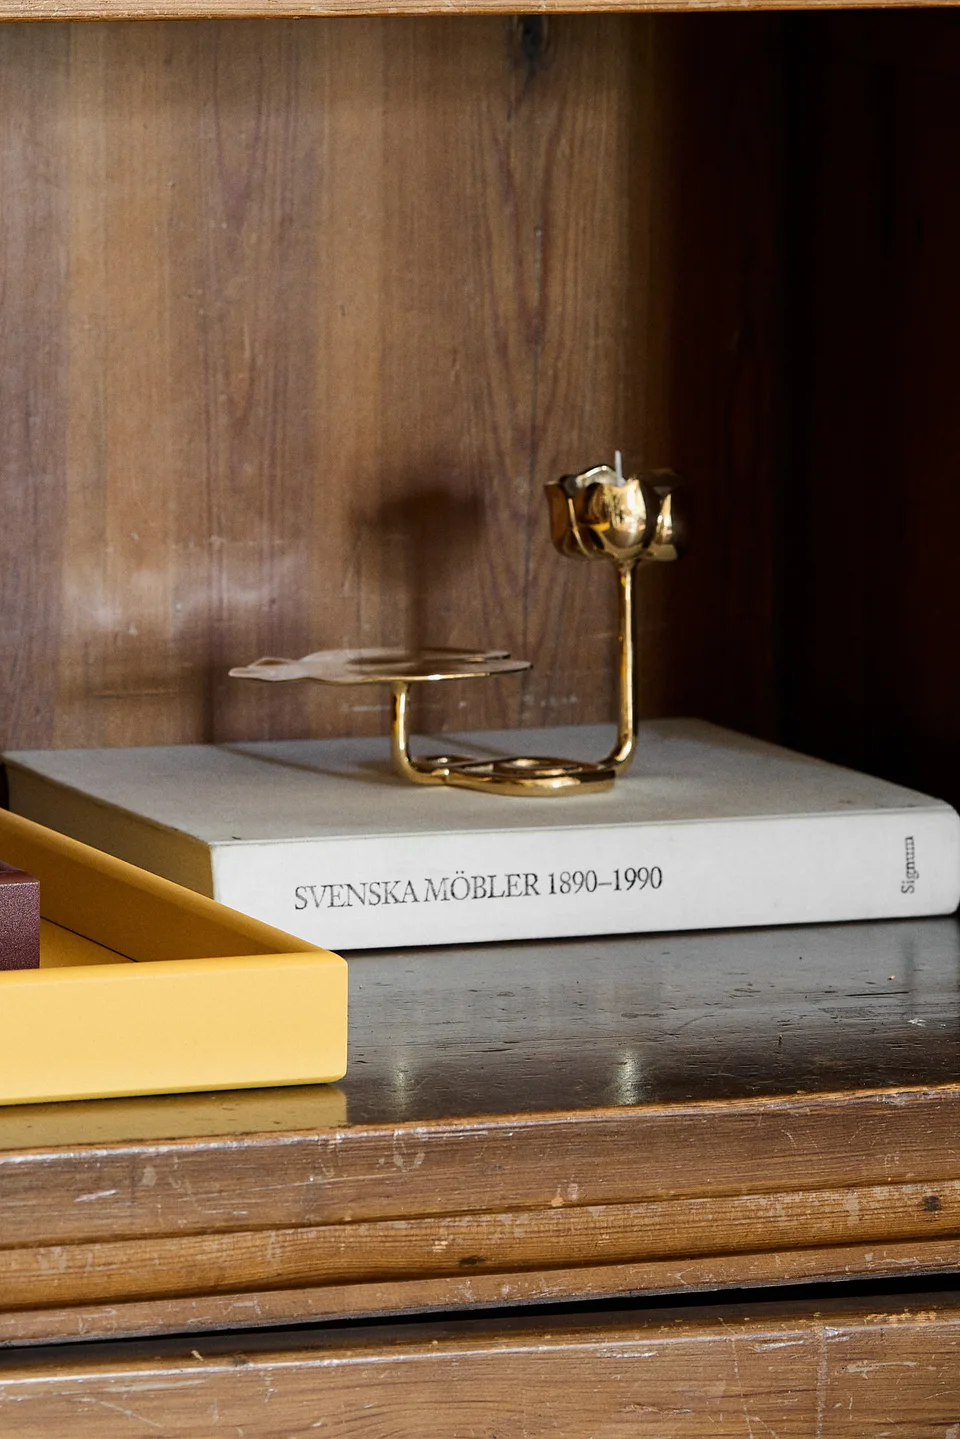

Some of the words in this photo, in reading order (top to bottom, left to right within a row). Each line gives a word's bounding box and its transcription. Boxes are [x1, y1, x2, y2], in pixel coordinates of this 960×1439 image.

[900, 836, 920, 894] Signum
[294, 879, 421, 910] SVENSKA
[423, 870, 541, 903] MÖBLER
